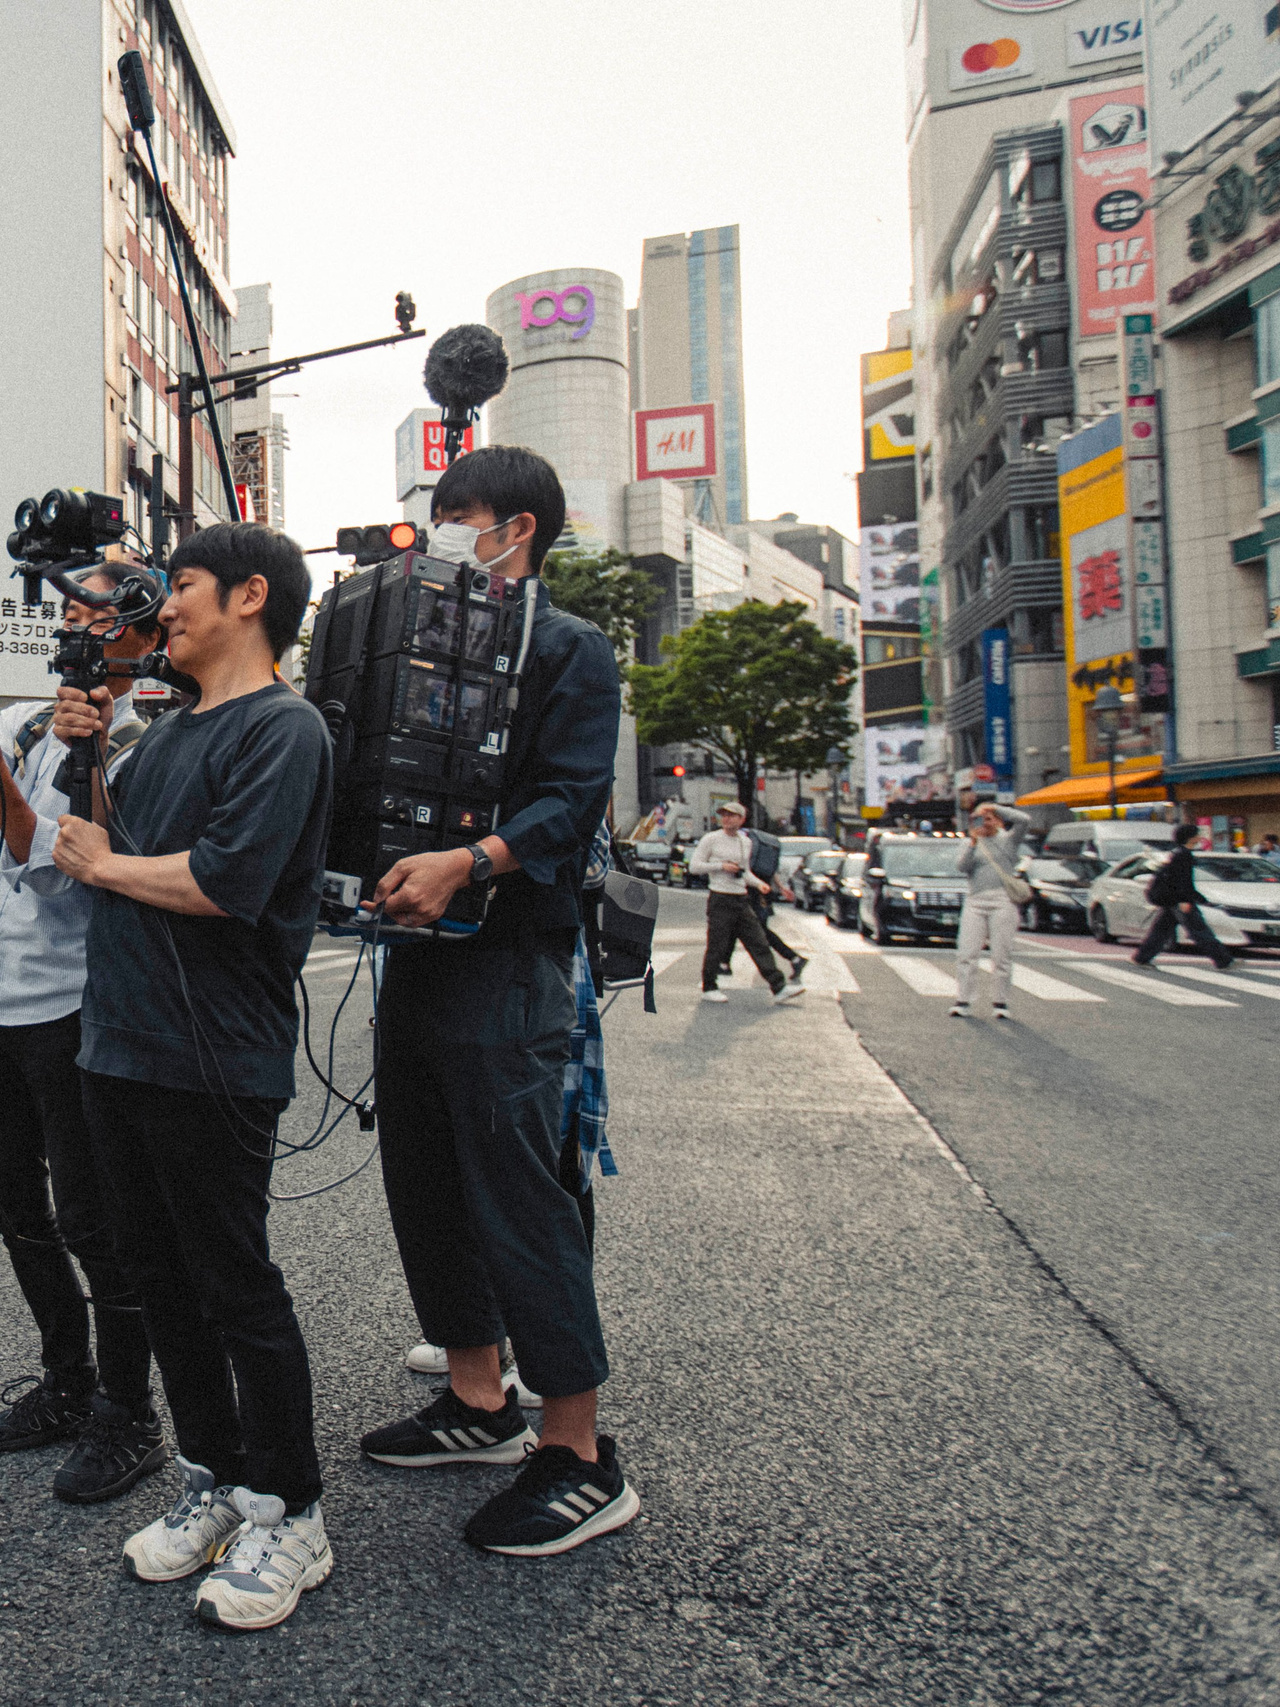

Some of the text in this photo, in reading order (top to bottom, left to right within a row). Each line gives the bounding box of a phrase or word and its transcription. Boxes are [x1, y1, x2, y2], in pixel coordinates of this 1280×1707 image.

[513, 285, 595, 340] 109
[497, 659, 507, 671] R
[487, 735, 497, 748] L
[418, 808, 428, 821] R
